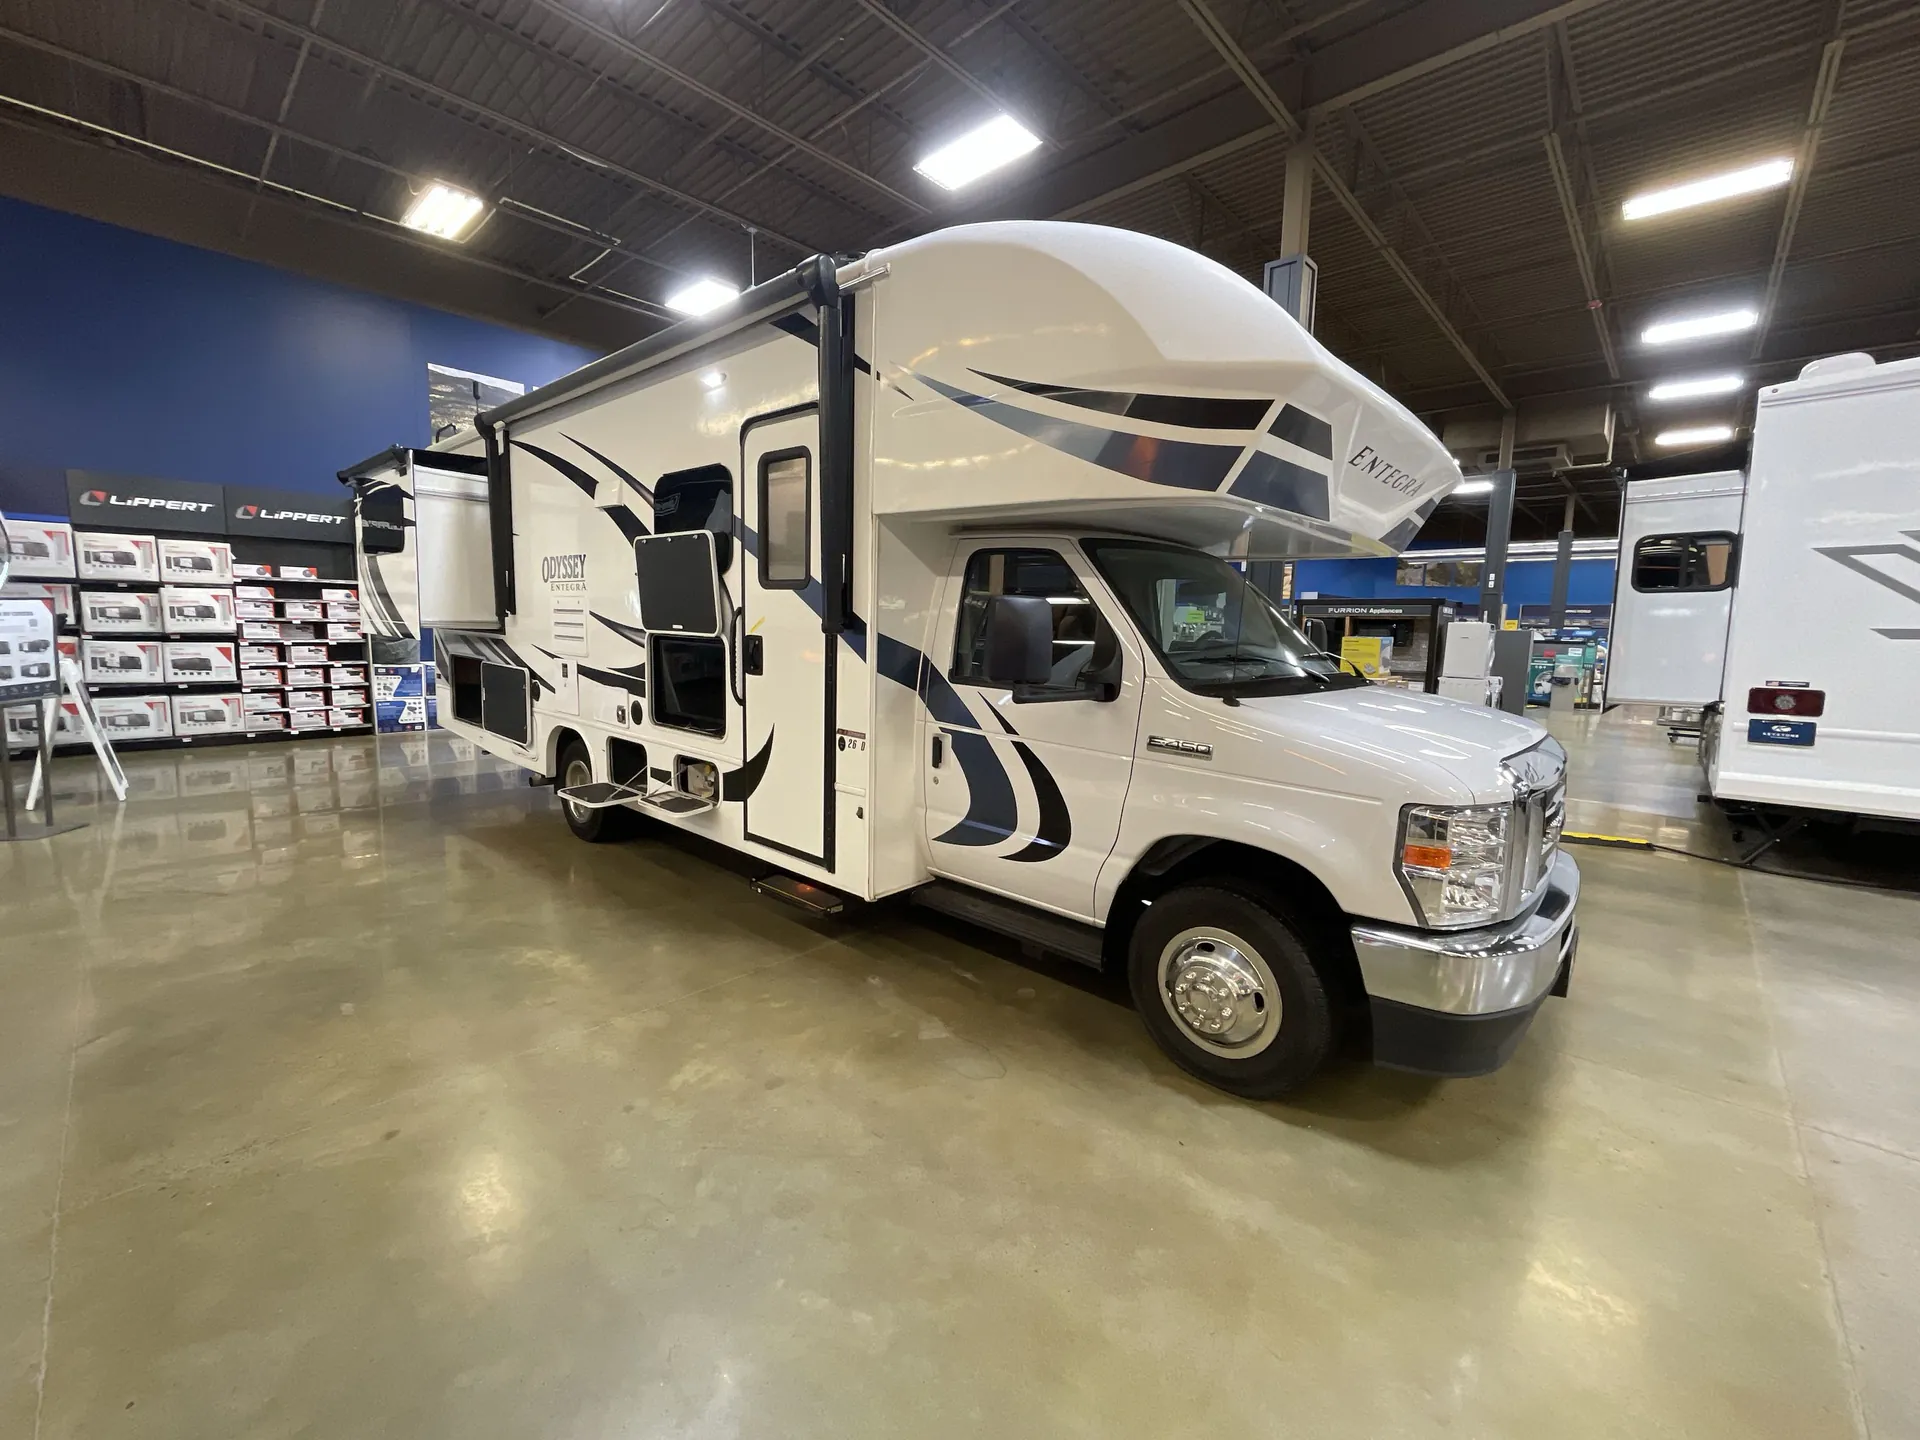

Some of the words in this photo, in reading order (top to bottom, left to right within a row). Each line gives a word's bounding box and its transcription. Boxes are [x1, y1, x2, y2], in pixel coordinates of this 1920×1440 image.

[1348, 445, 1425, 496] ENTEGRA
[542, 554, 586, 583] ODYSSEY
[550, 582, 587, 591] ENTEGRA
[847, 738, 857, 750] 26
